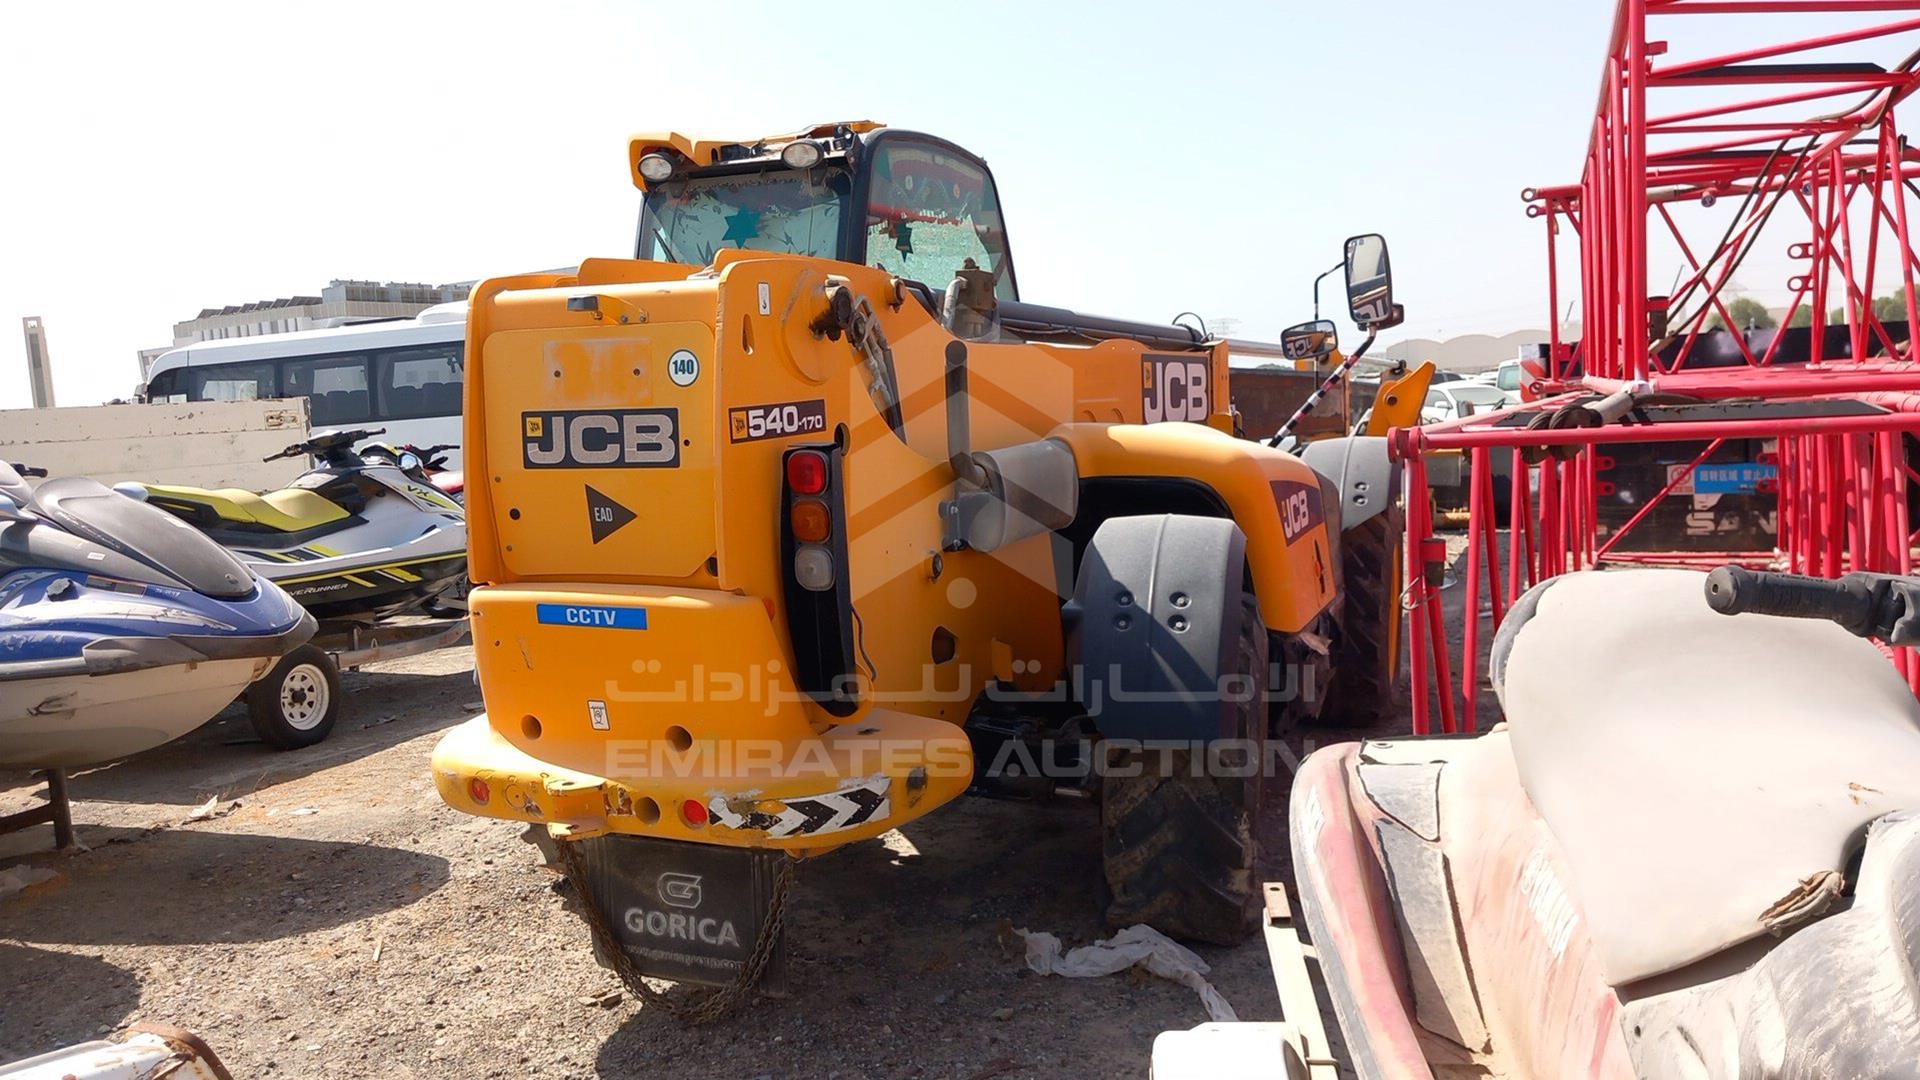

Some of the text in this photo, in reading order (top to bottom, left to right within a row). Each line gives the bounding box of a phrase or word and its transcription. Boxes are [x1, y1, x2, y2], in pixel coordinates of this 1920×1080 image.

[672, 359, 694, 375] 140
[1144, 361, 1207, 424] JCB
[526, 414, 676, 464] JCB
[594, 507, 613, 522] EAD
[1283, 489, 1310, 539] JCB
[565, 607, 617, 625] CCTV
[623, 906, 741, 948] GORICA
